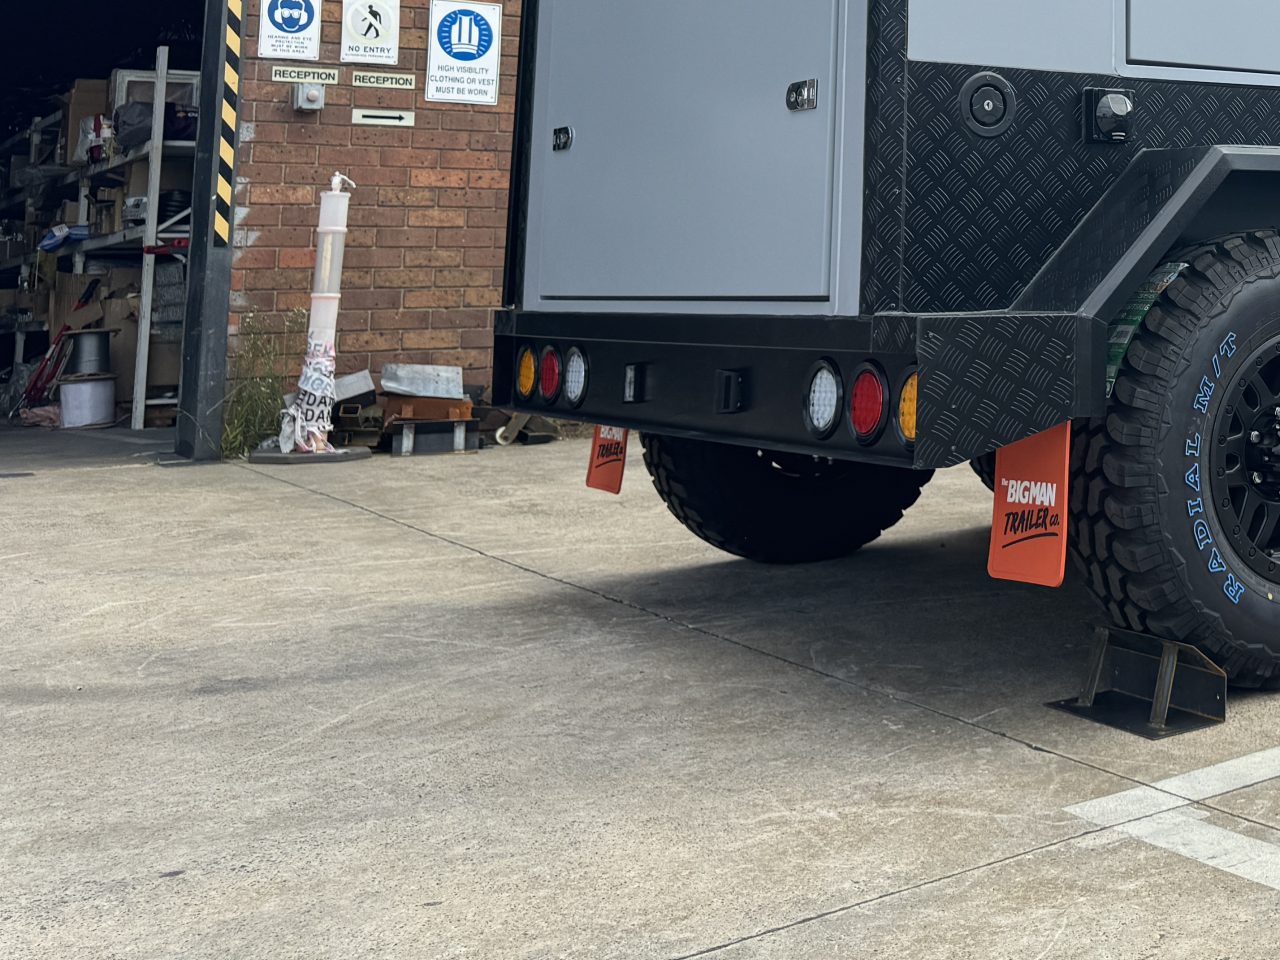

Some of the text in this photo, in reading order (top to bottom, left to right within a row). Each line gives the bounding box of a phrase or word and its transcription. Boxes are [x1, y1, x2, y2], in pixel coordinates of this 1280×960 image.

[363, 46, 392, 54] ENTRY
[274, 69, 336, 81] RECEPTION
[437, 64, 489, 75] HIGH VISIBILITY
[354, 74, 413, 86] RECEPTION
[430, 75, 495, 86] CLOTHING OR VEST
[435, 86, 488, 96] MUST BE WORN
[1194, 332, 1237, 414] M/T
[1007, 479, 1057, 507] BIGMAN
[1004, 507, 1049, 535] TRAILER
[1185, 432, 1245, 604] RADIAL
